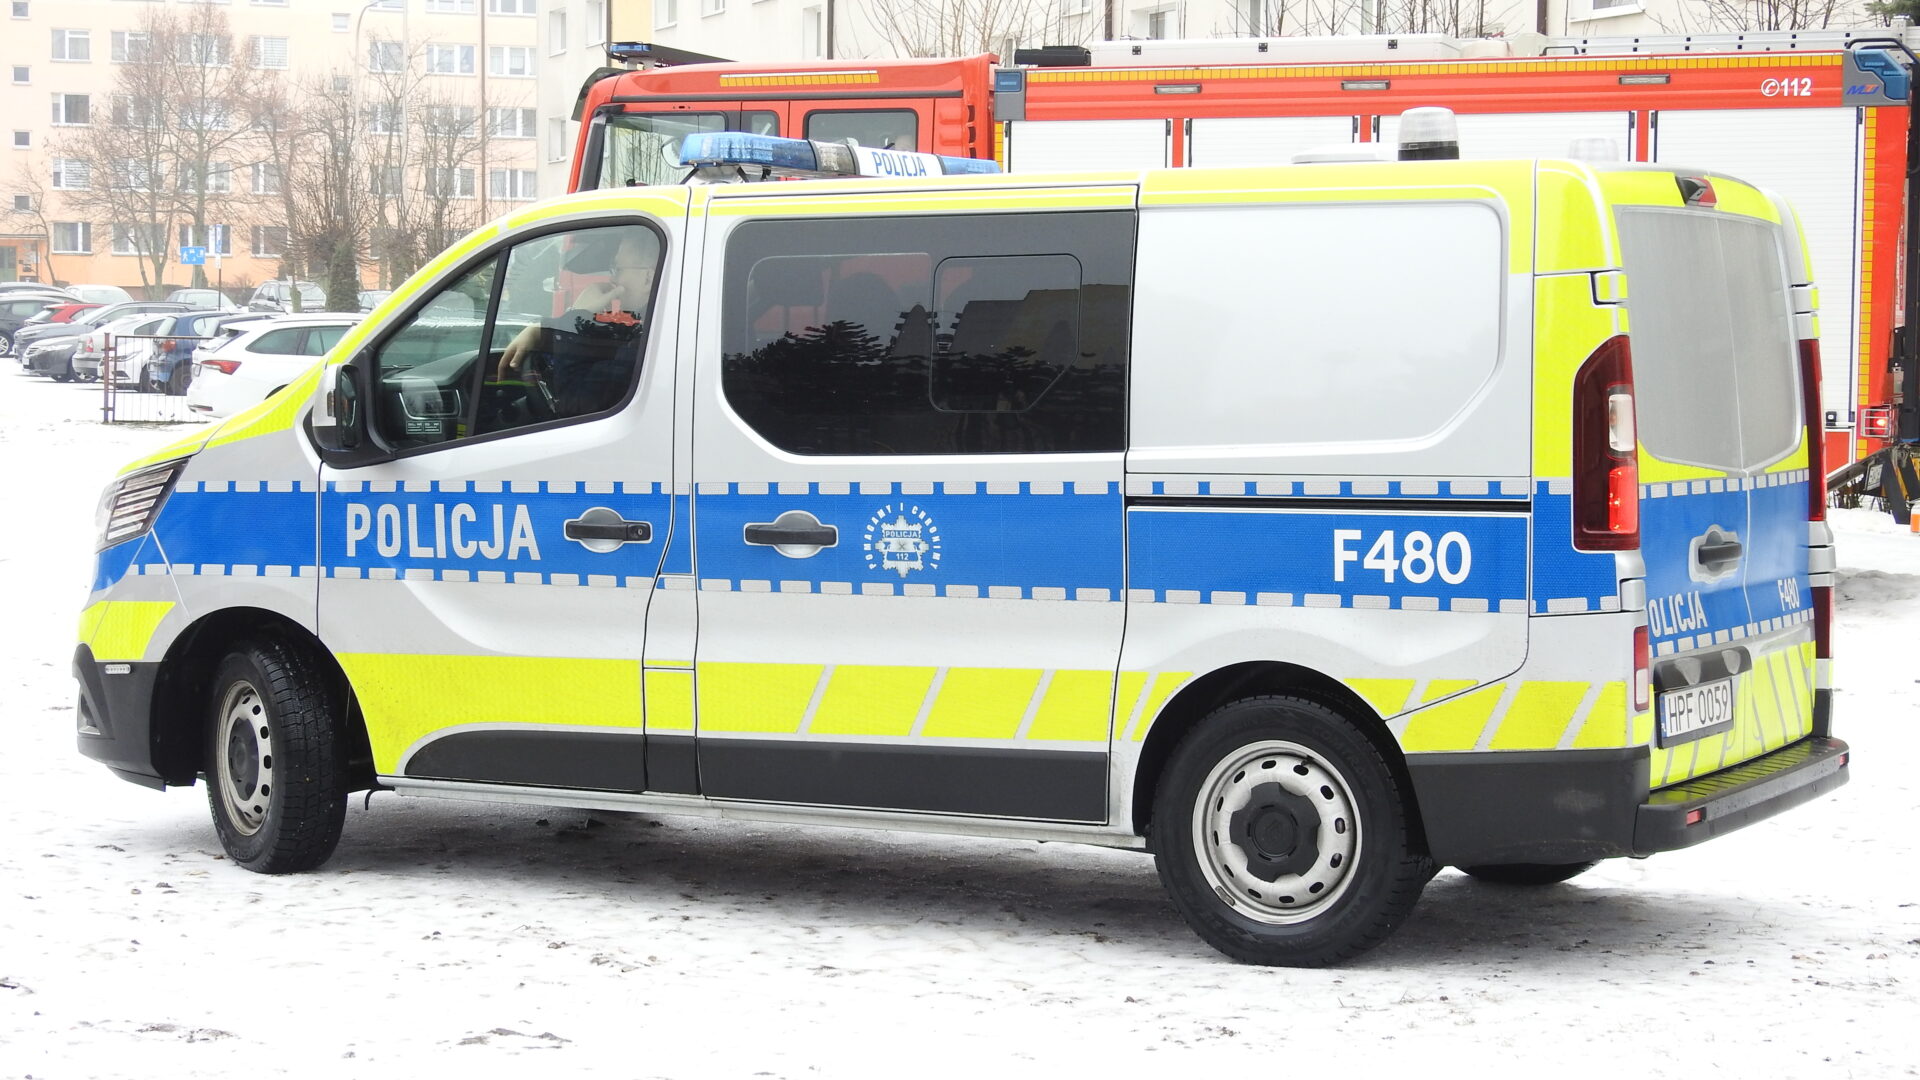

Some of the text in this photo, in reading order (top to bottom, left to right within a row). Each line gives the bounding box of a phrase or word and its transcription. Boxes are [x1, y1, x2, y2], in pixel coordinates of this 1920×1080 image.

[1781, 78, 1812, 97] 112
[872, 151, 927, 176] POLICJA
[346, 503, 541, 561] POLICJA
[885, 530, 918, 538] POLICJA
[896, 553, 909, 561] 112
[1334, 529, 1472, 585] F480
[1777, 577, 1800, 611] F480
[1648, 590, 1708, 637] OLICJA
[1668, 684, 1728, 733] HPF 0059
